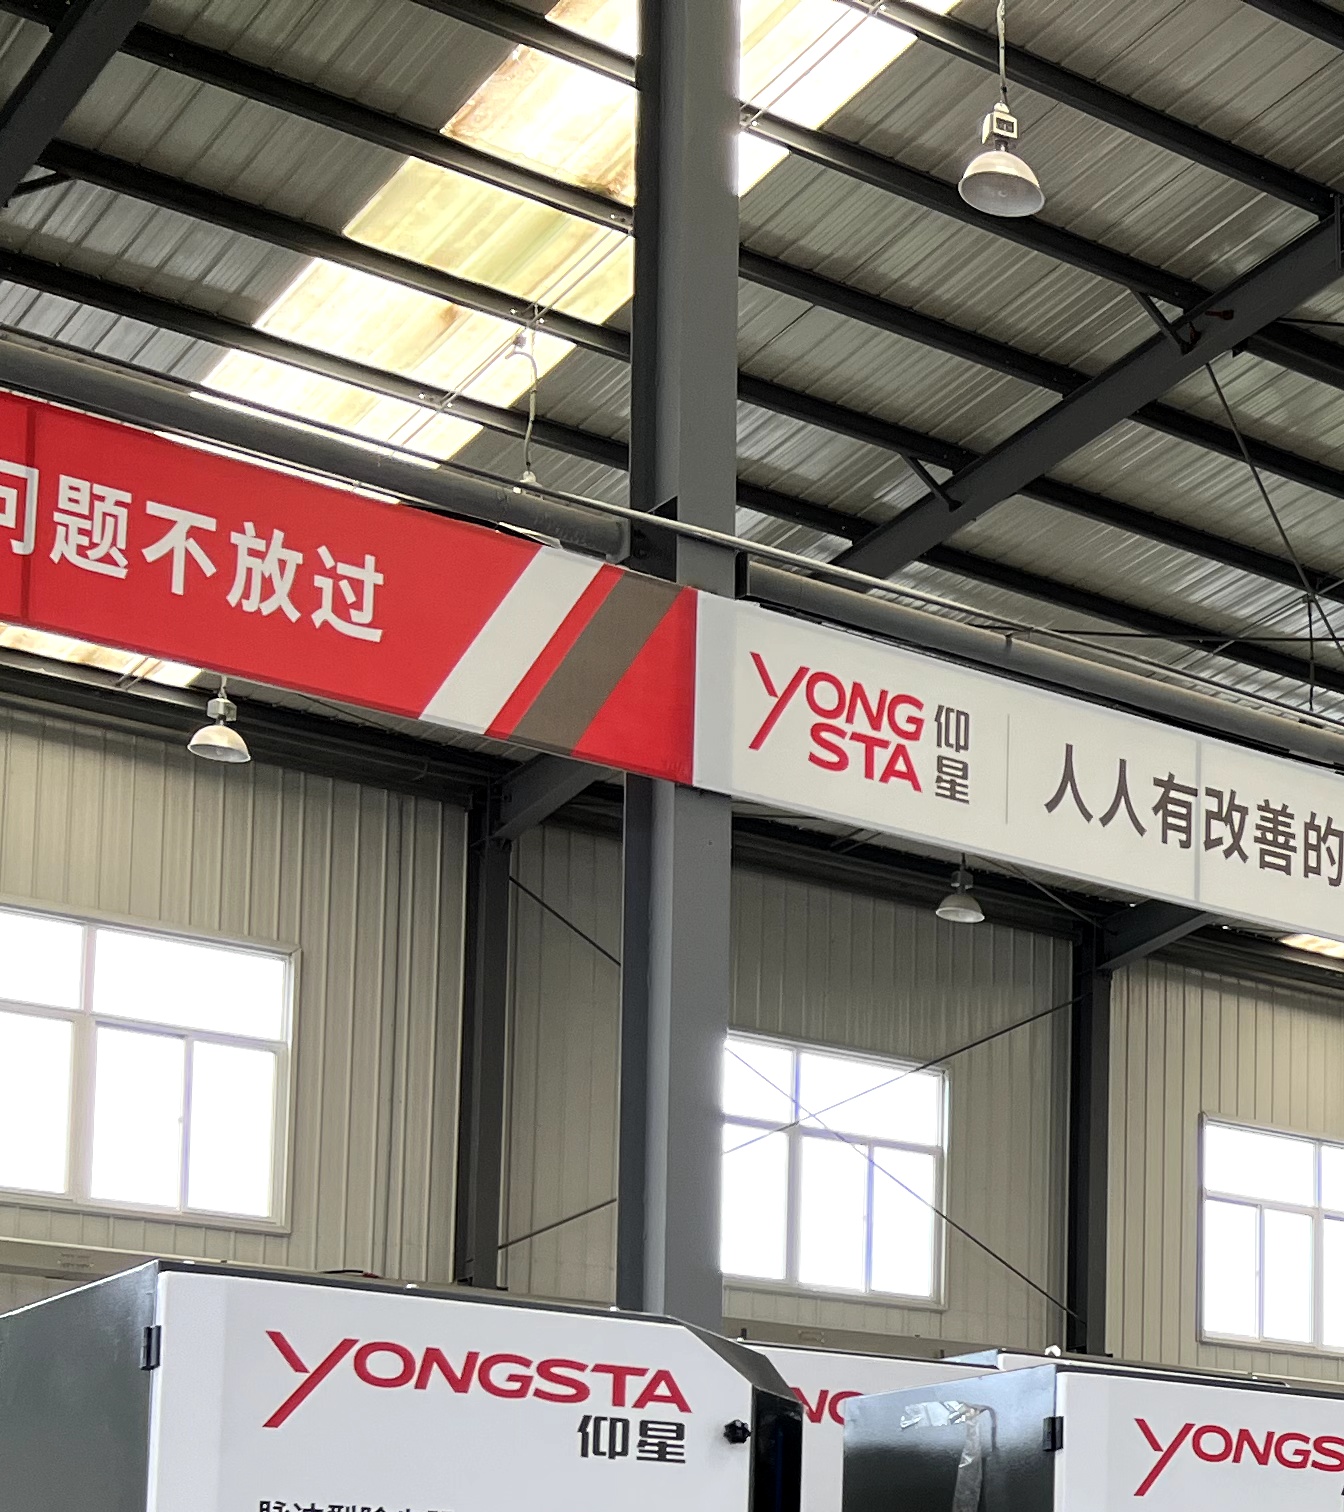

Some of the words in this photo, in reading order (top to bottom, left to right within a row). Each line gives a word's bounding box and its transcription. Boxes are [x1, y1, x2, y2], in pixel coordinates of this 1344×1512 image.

[749, 652, 925, 751] YONG
[808, 723, 923, 793] STA
[934, 704, 970, 804] 仰星
[262, 1331, 694, 1428] YONGSTA
[577, 1414, 686, 1464] 仰星
